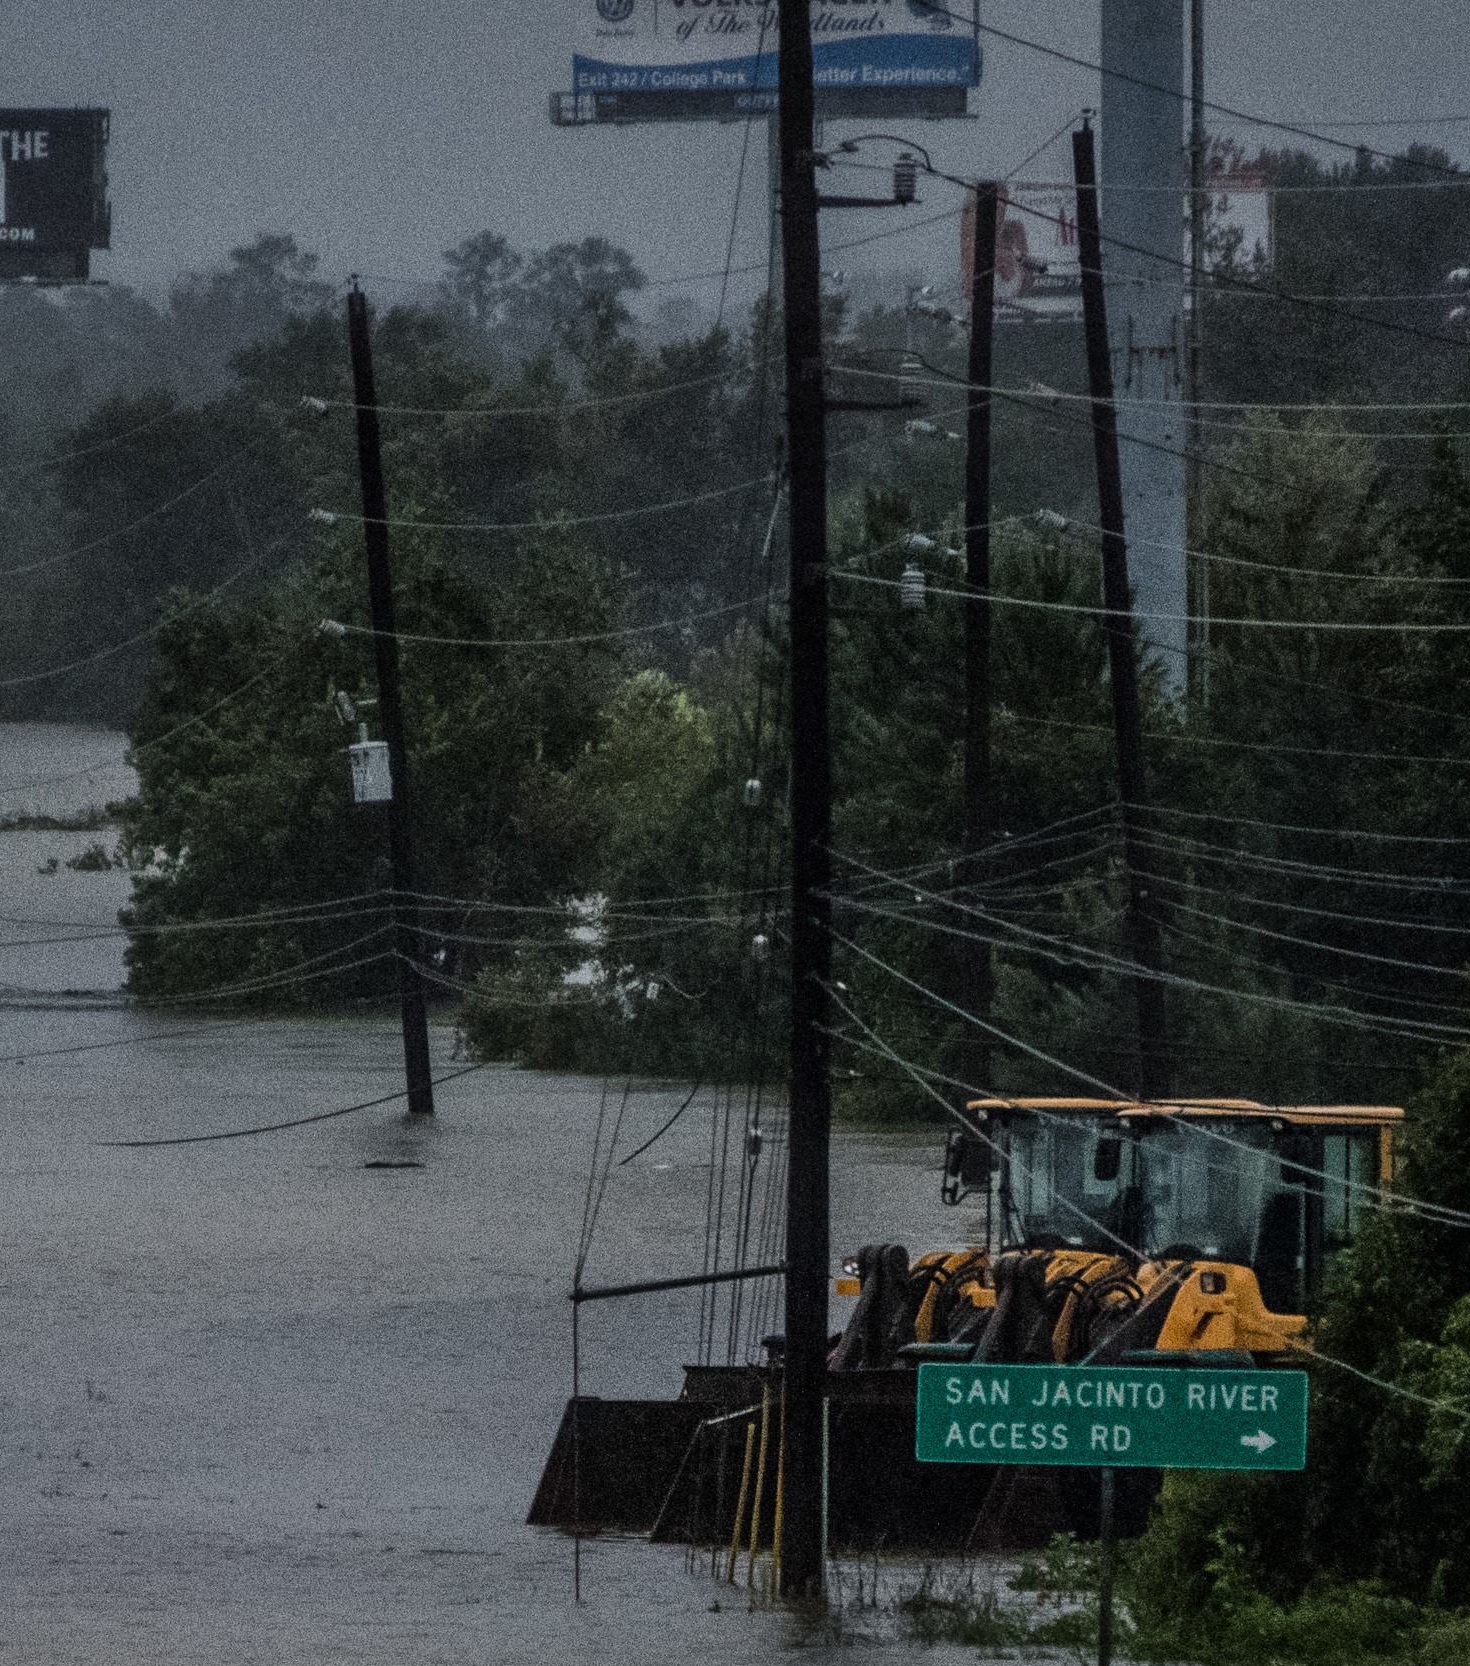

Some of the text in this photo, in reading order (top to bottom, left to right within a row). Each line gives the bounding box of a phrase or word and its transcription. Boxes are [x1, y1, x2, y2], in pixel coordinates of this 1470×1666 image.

[650, 69, 708, 89] College
[711, 68, 747, 86] Park
[812, 68, 857, 84] etter
[946, 1377, 1279, 1411] SAN JACINTO RIVER
[945, 1422, 1132, 1452] ACCESS RD
